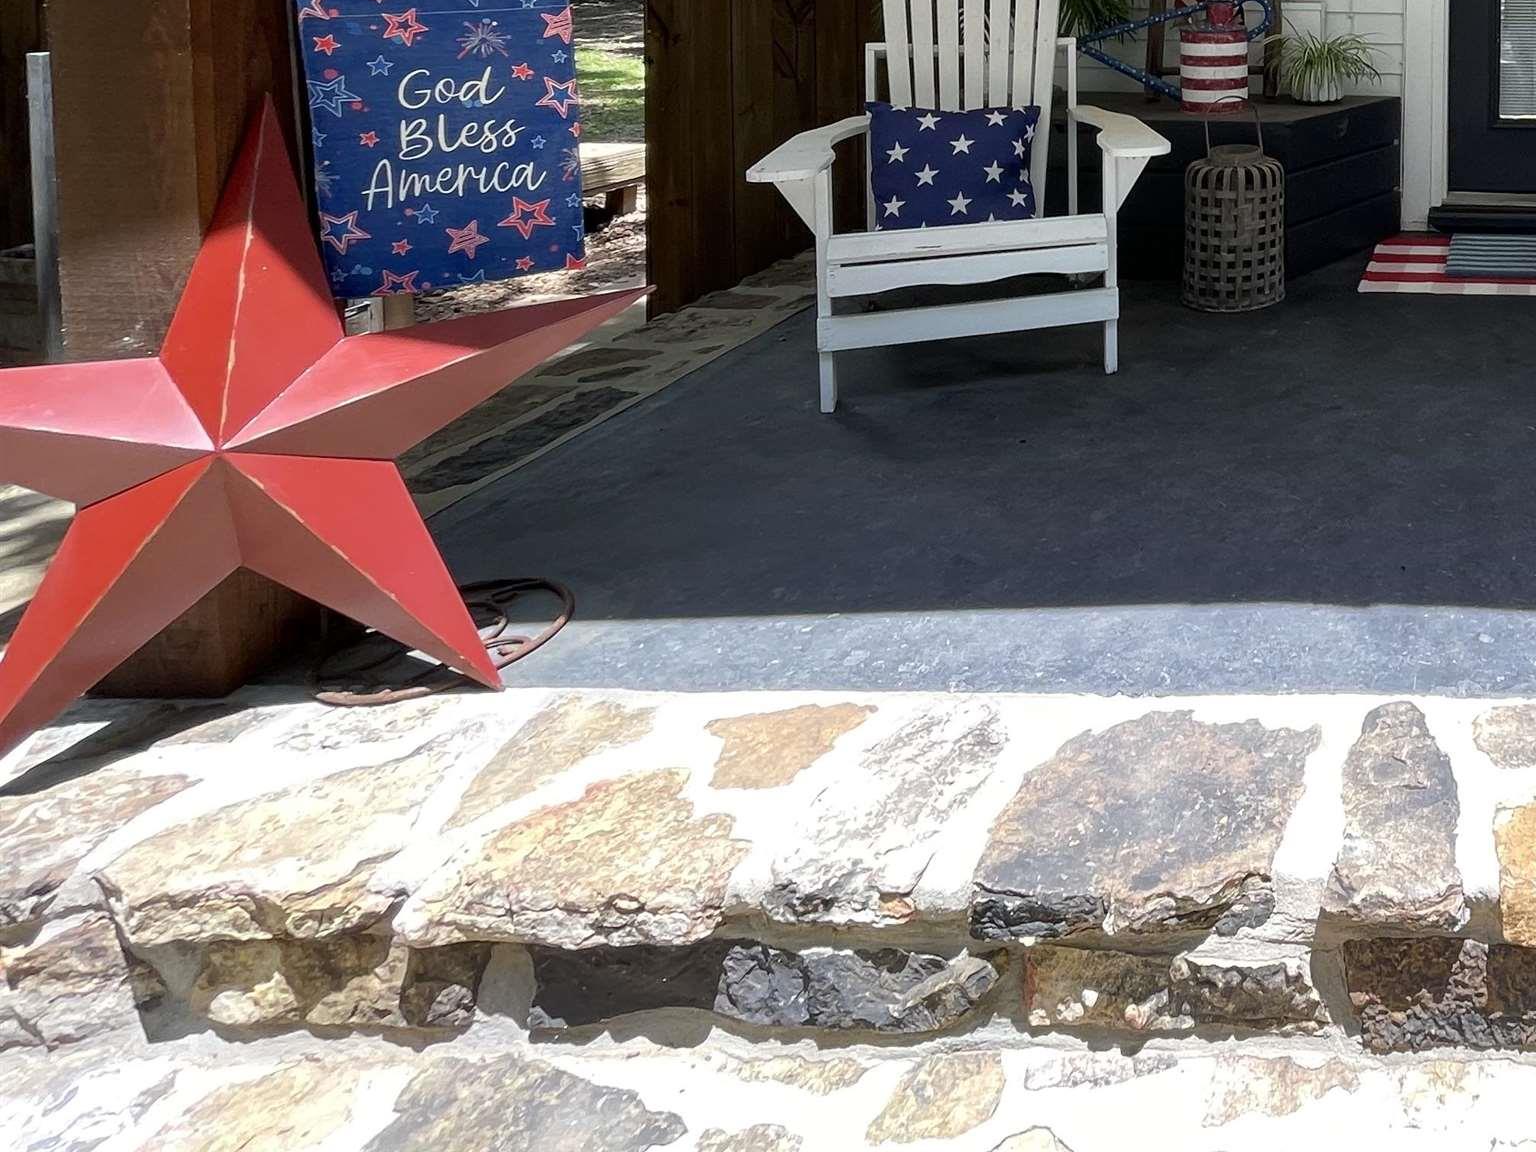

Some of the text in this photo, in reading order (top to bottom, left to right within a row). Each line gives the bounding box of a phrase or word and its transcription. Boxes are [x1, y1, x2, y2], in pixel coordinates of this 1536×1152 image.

[398, 66, 505, 109] God
[399, 114, 526, 160] Bless
[361, 158, 547, 211] America
